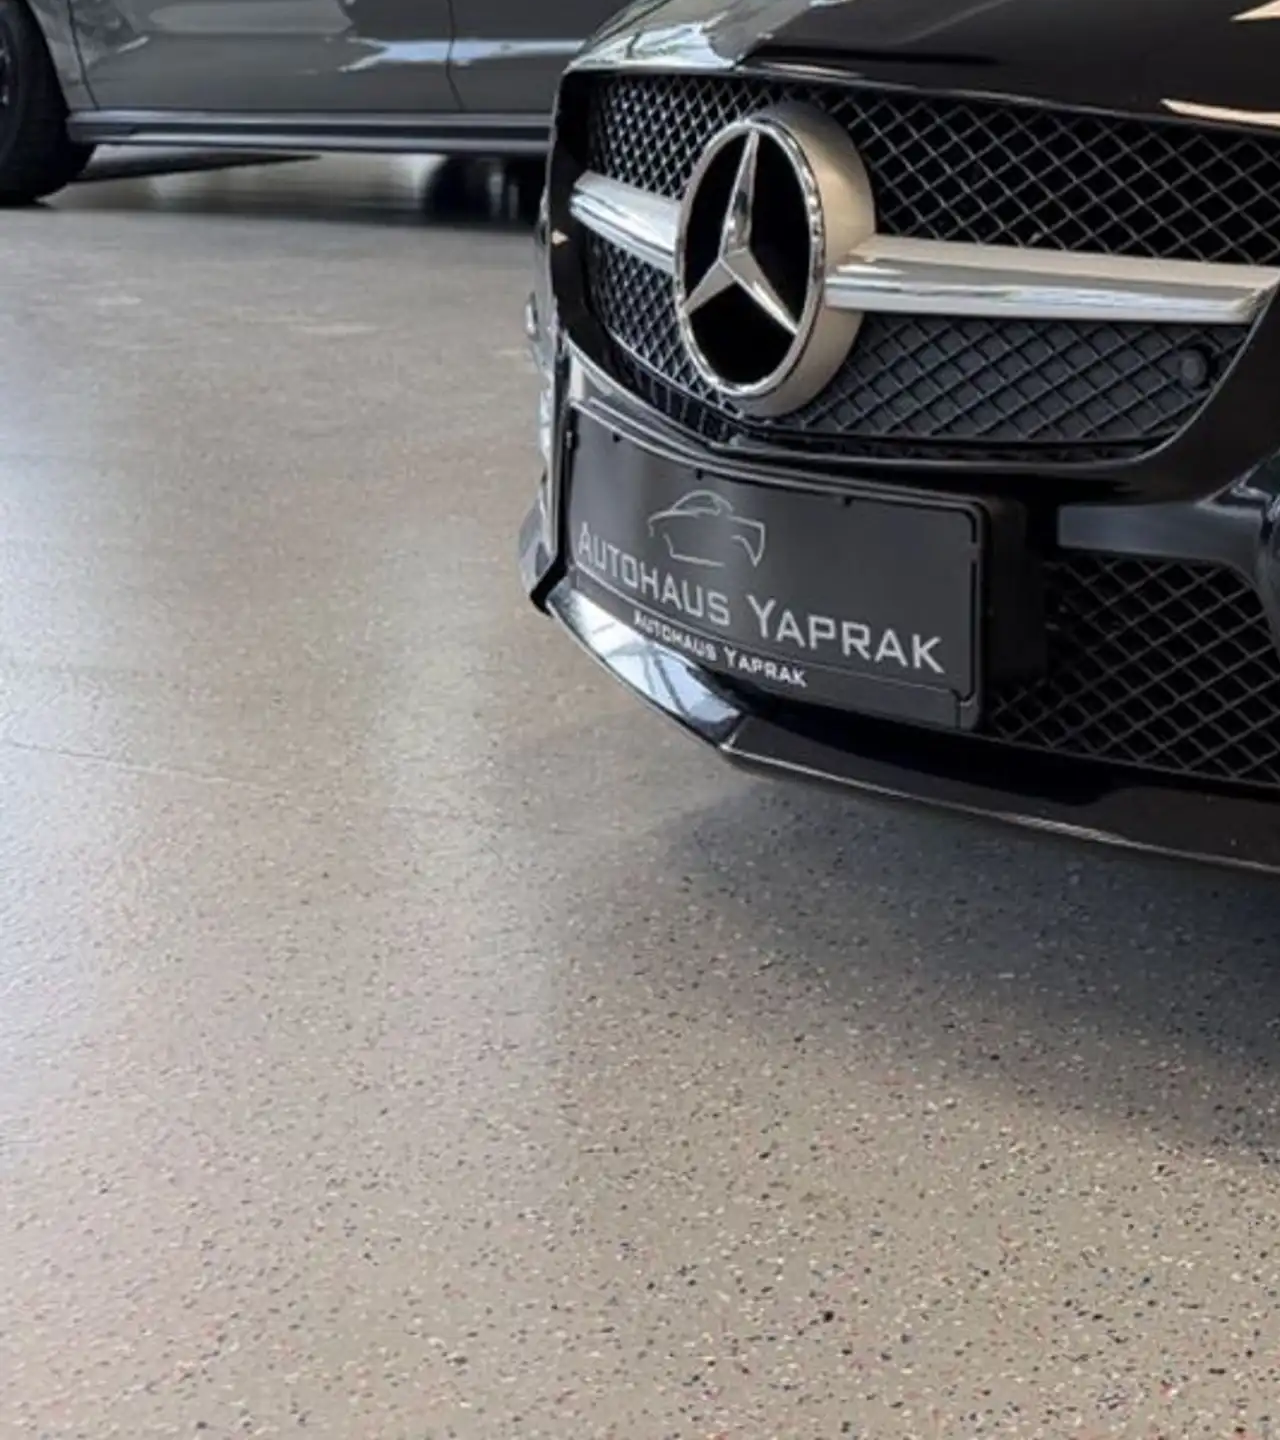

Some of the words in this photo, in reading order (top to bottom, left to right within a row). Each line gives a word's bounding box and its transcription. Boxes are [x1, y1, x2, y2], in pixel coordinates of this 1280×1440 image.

[578, 521, 730, 626] AUTOHAUS
[747, 594, 944, 674] YAPRAK
[634, 610, 717, 661] AUTOHAUS
[723, 646, 807, 688] YAPRAK
